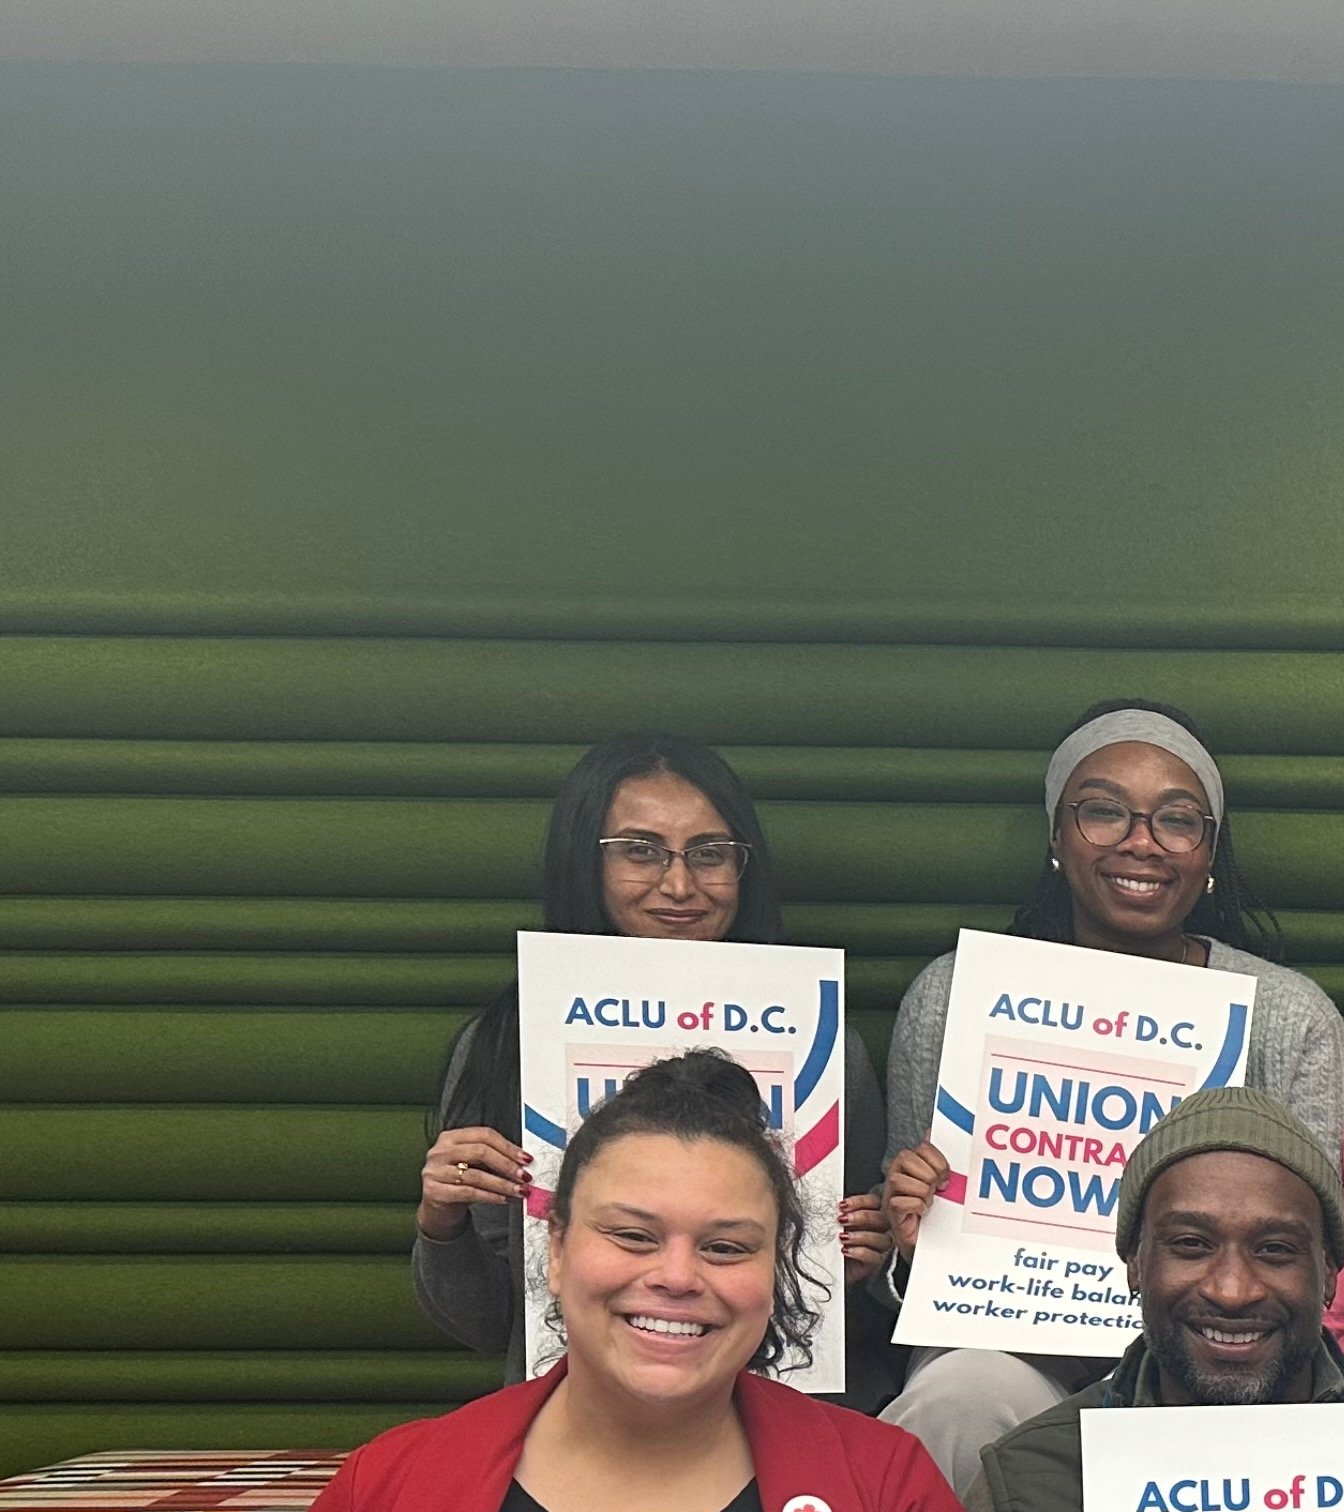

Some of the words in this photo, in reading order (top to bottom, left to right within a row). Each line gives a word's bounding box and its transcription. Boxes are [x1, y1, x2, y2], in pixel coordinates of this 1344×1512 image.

[565, 997, 666, 1029] ACLU
[677, 1002, 715, 1031] of
[724, 1004, 797, 1035] D.C.
[990, 994, 1085, 1031] ACLU
[1093, 1012, 1130, 1038] of
[1136, 1015, 1203, 1051] D.C.
[989, 1068, 1182, 1134] UNION
[985, 1124, 1127, 1168] CONTRA
[979, 1158, 1121, 1217] NOW
[1013, 1248, 1059, 1270] fair
[1065, 1261, 1114, 1281] pay
[948, 1274, 1065, 1299] work-life
[1072, 1284, 1141, 1306] balan
[932, 1300, 1028, 1319] worker
[1033, 1310, 1143, 1329] protectio
[1264, 1475, 1306, 1511] of
